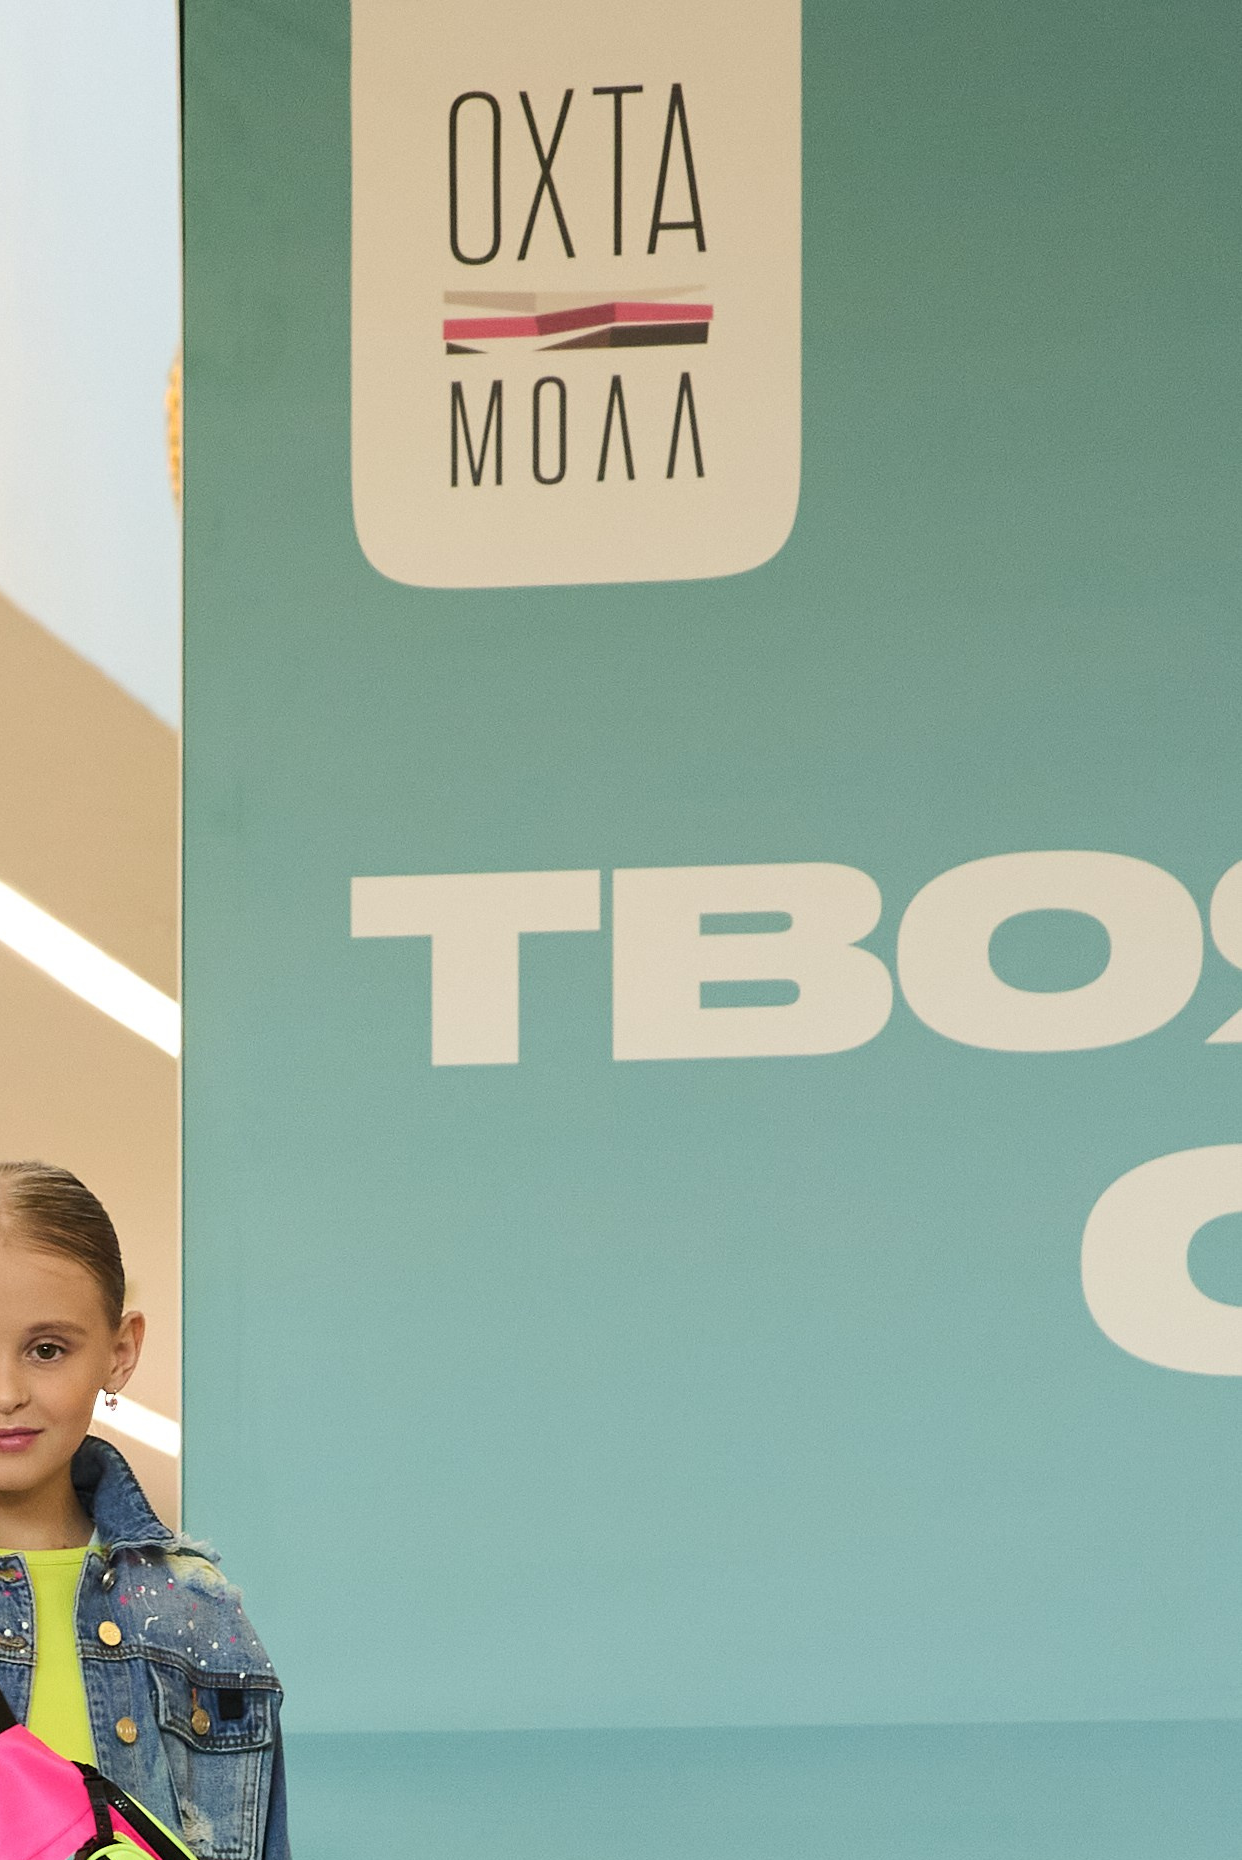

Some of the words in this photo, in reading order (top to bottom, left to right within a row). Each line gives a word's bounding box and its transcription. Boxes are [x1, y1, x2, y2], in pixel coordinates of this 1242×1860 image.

[448, 82, 707, 266] ОХТА
[450, 372, 705, 488] МОЛЛ
[350, 849, 1242, 1066] ТВО
